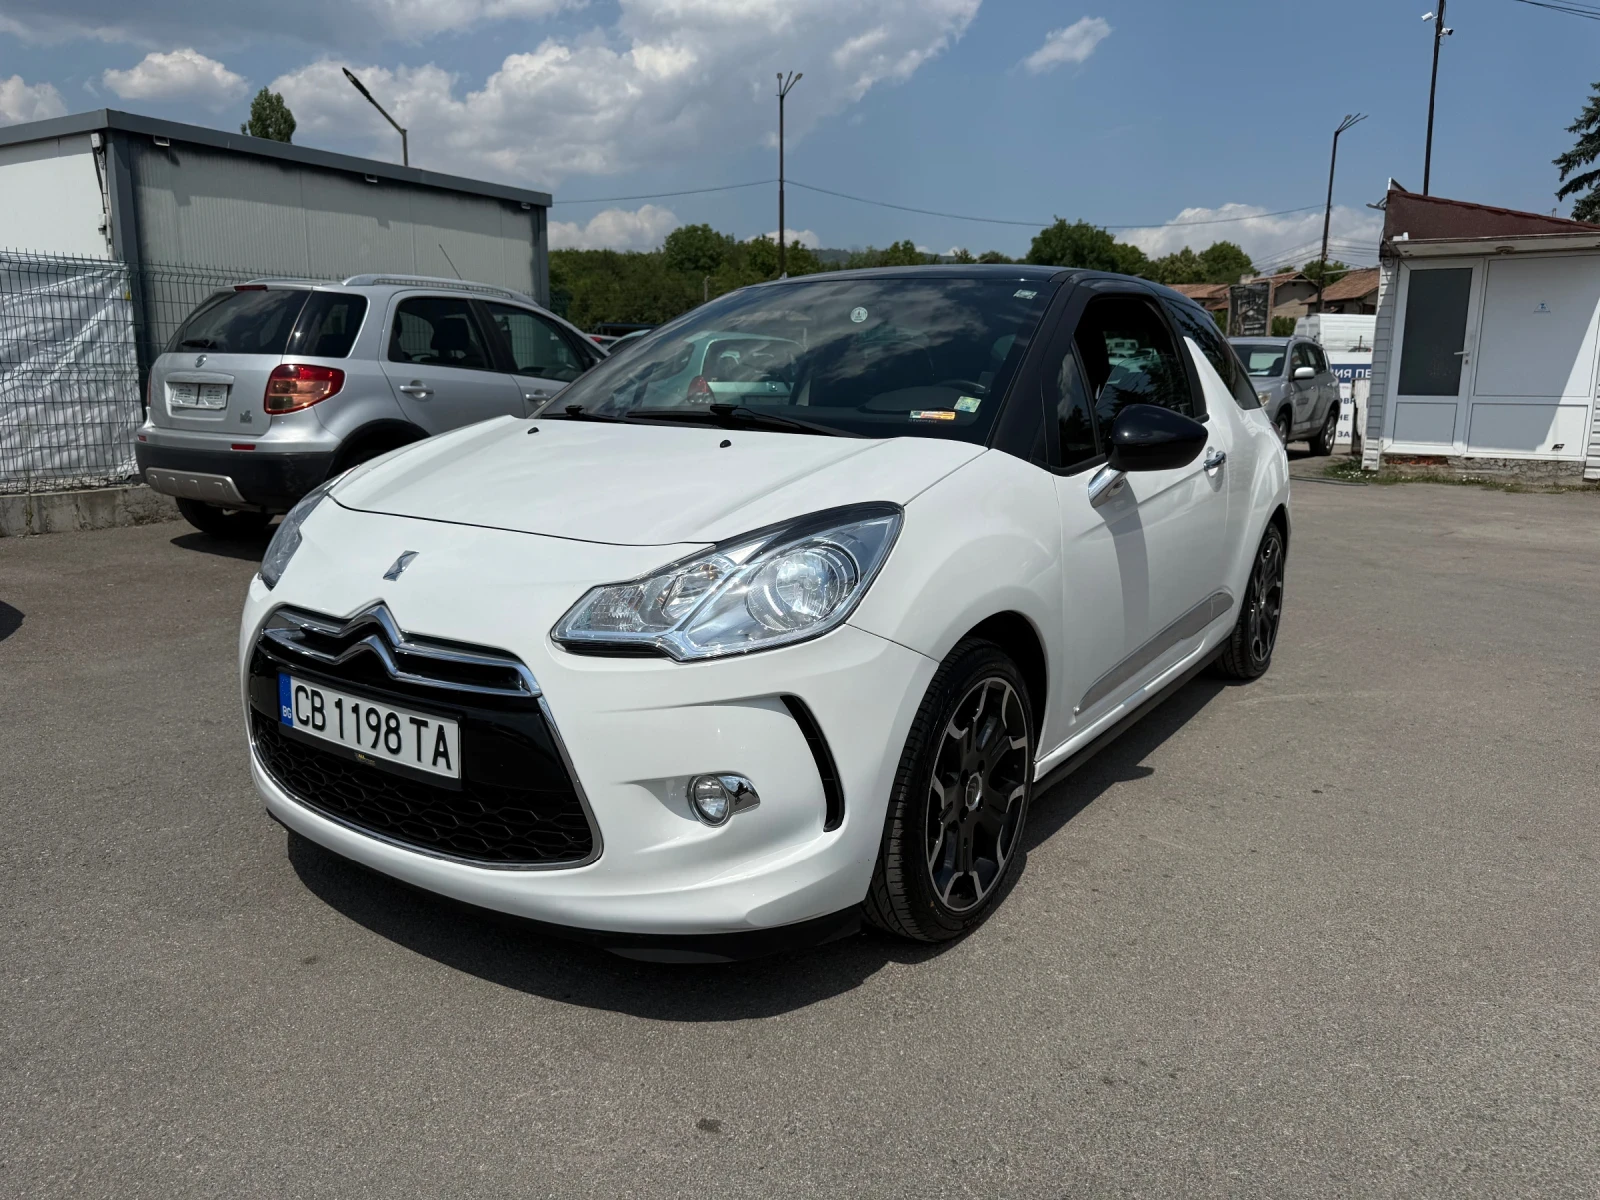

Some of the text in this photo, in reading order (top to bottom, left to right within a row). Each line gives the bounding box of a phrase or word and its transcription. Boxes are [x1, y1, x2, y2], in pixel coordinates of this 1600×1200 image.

[1332, 369, 1352, 378] ИЯ
[282, 705, 292, 719] BG
[295, 685, 452, 771] CB 1198 TA
